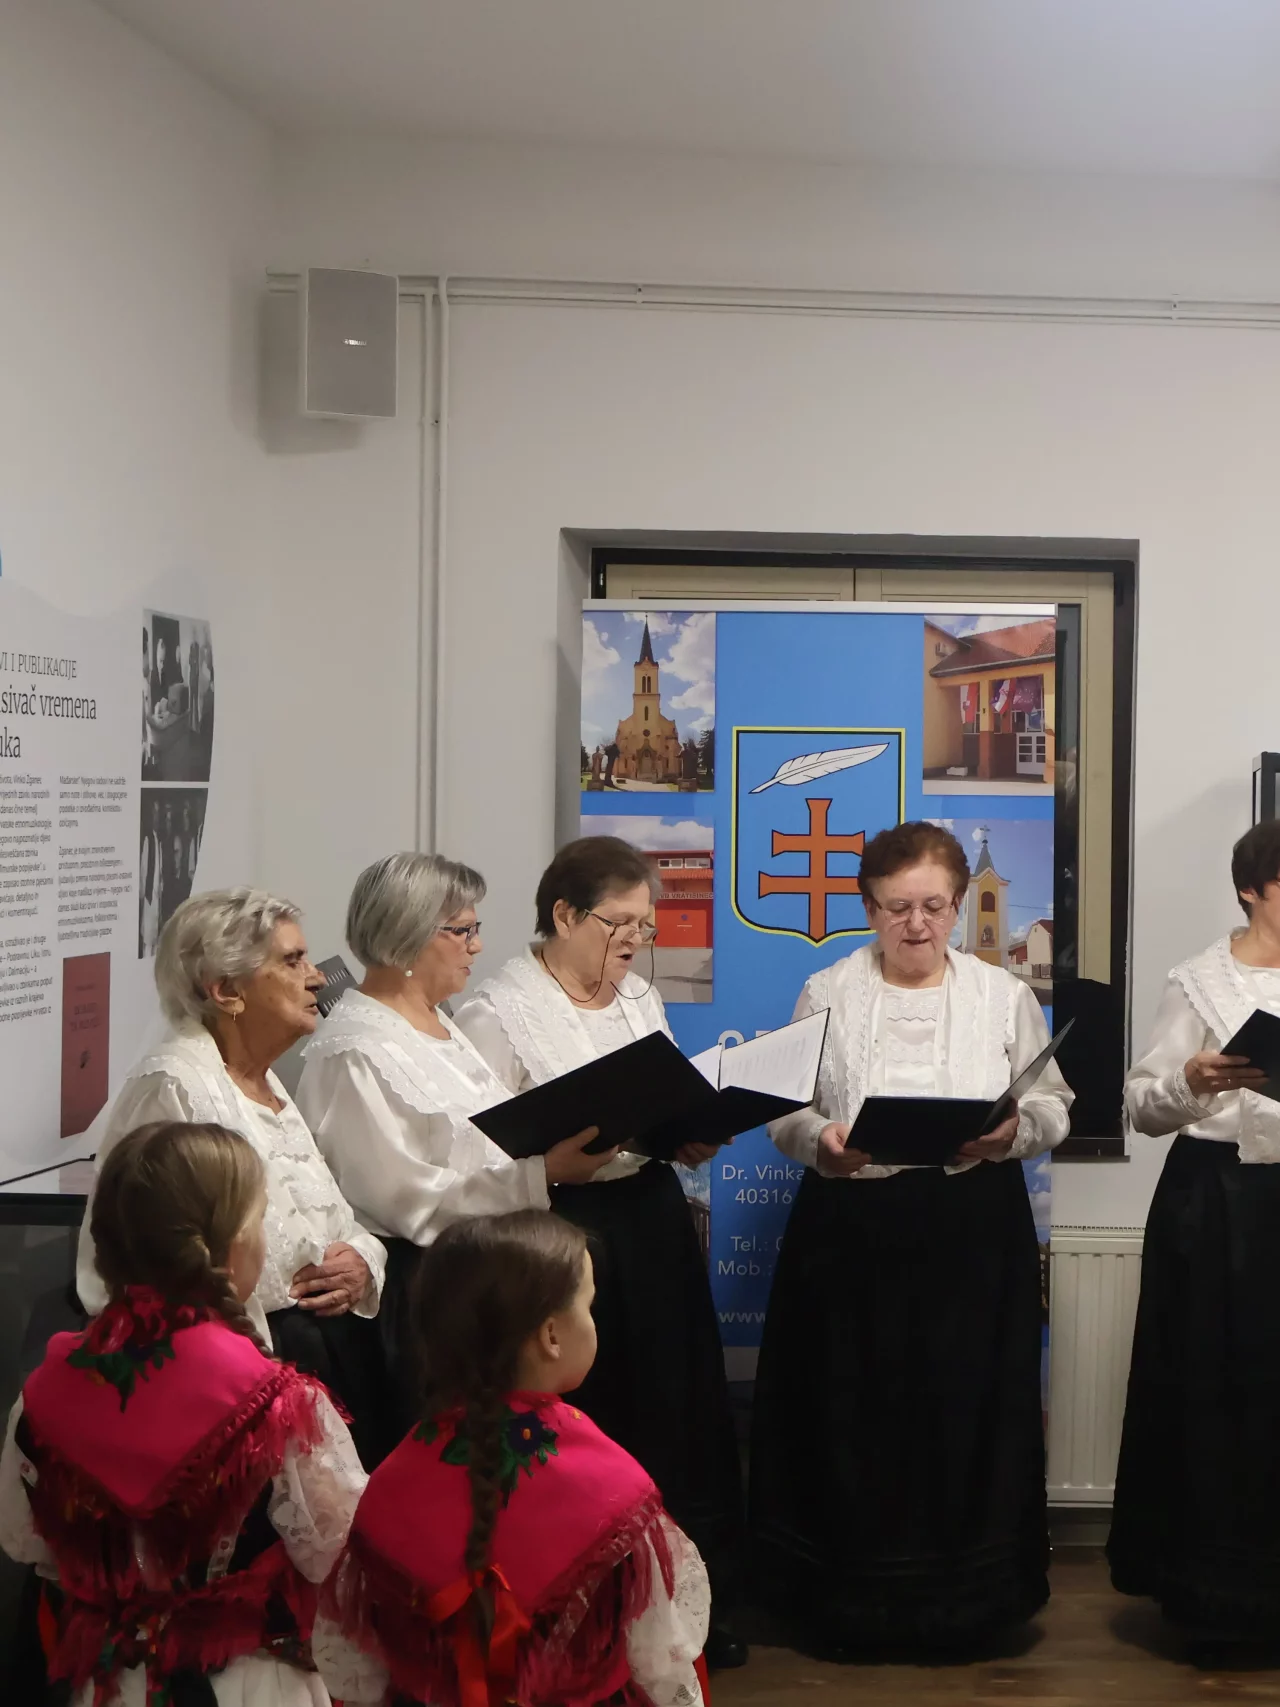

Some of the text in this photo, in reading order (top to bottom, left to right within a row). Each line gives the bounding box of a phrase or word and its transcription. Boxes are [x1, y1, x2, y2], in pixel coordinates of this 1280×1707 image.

[18, 654, 77, 680] PUBLIKACIJE
[0, 684, 97, 720] sivač vremena
[722, 1164, 805, 1181] Dr. Vinka
[735, 1188, 793, 1204] 40316
[730, 1236, 769, 1252] Tel.:
[718, 1260, 773, 1276] Mob.:
